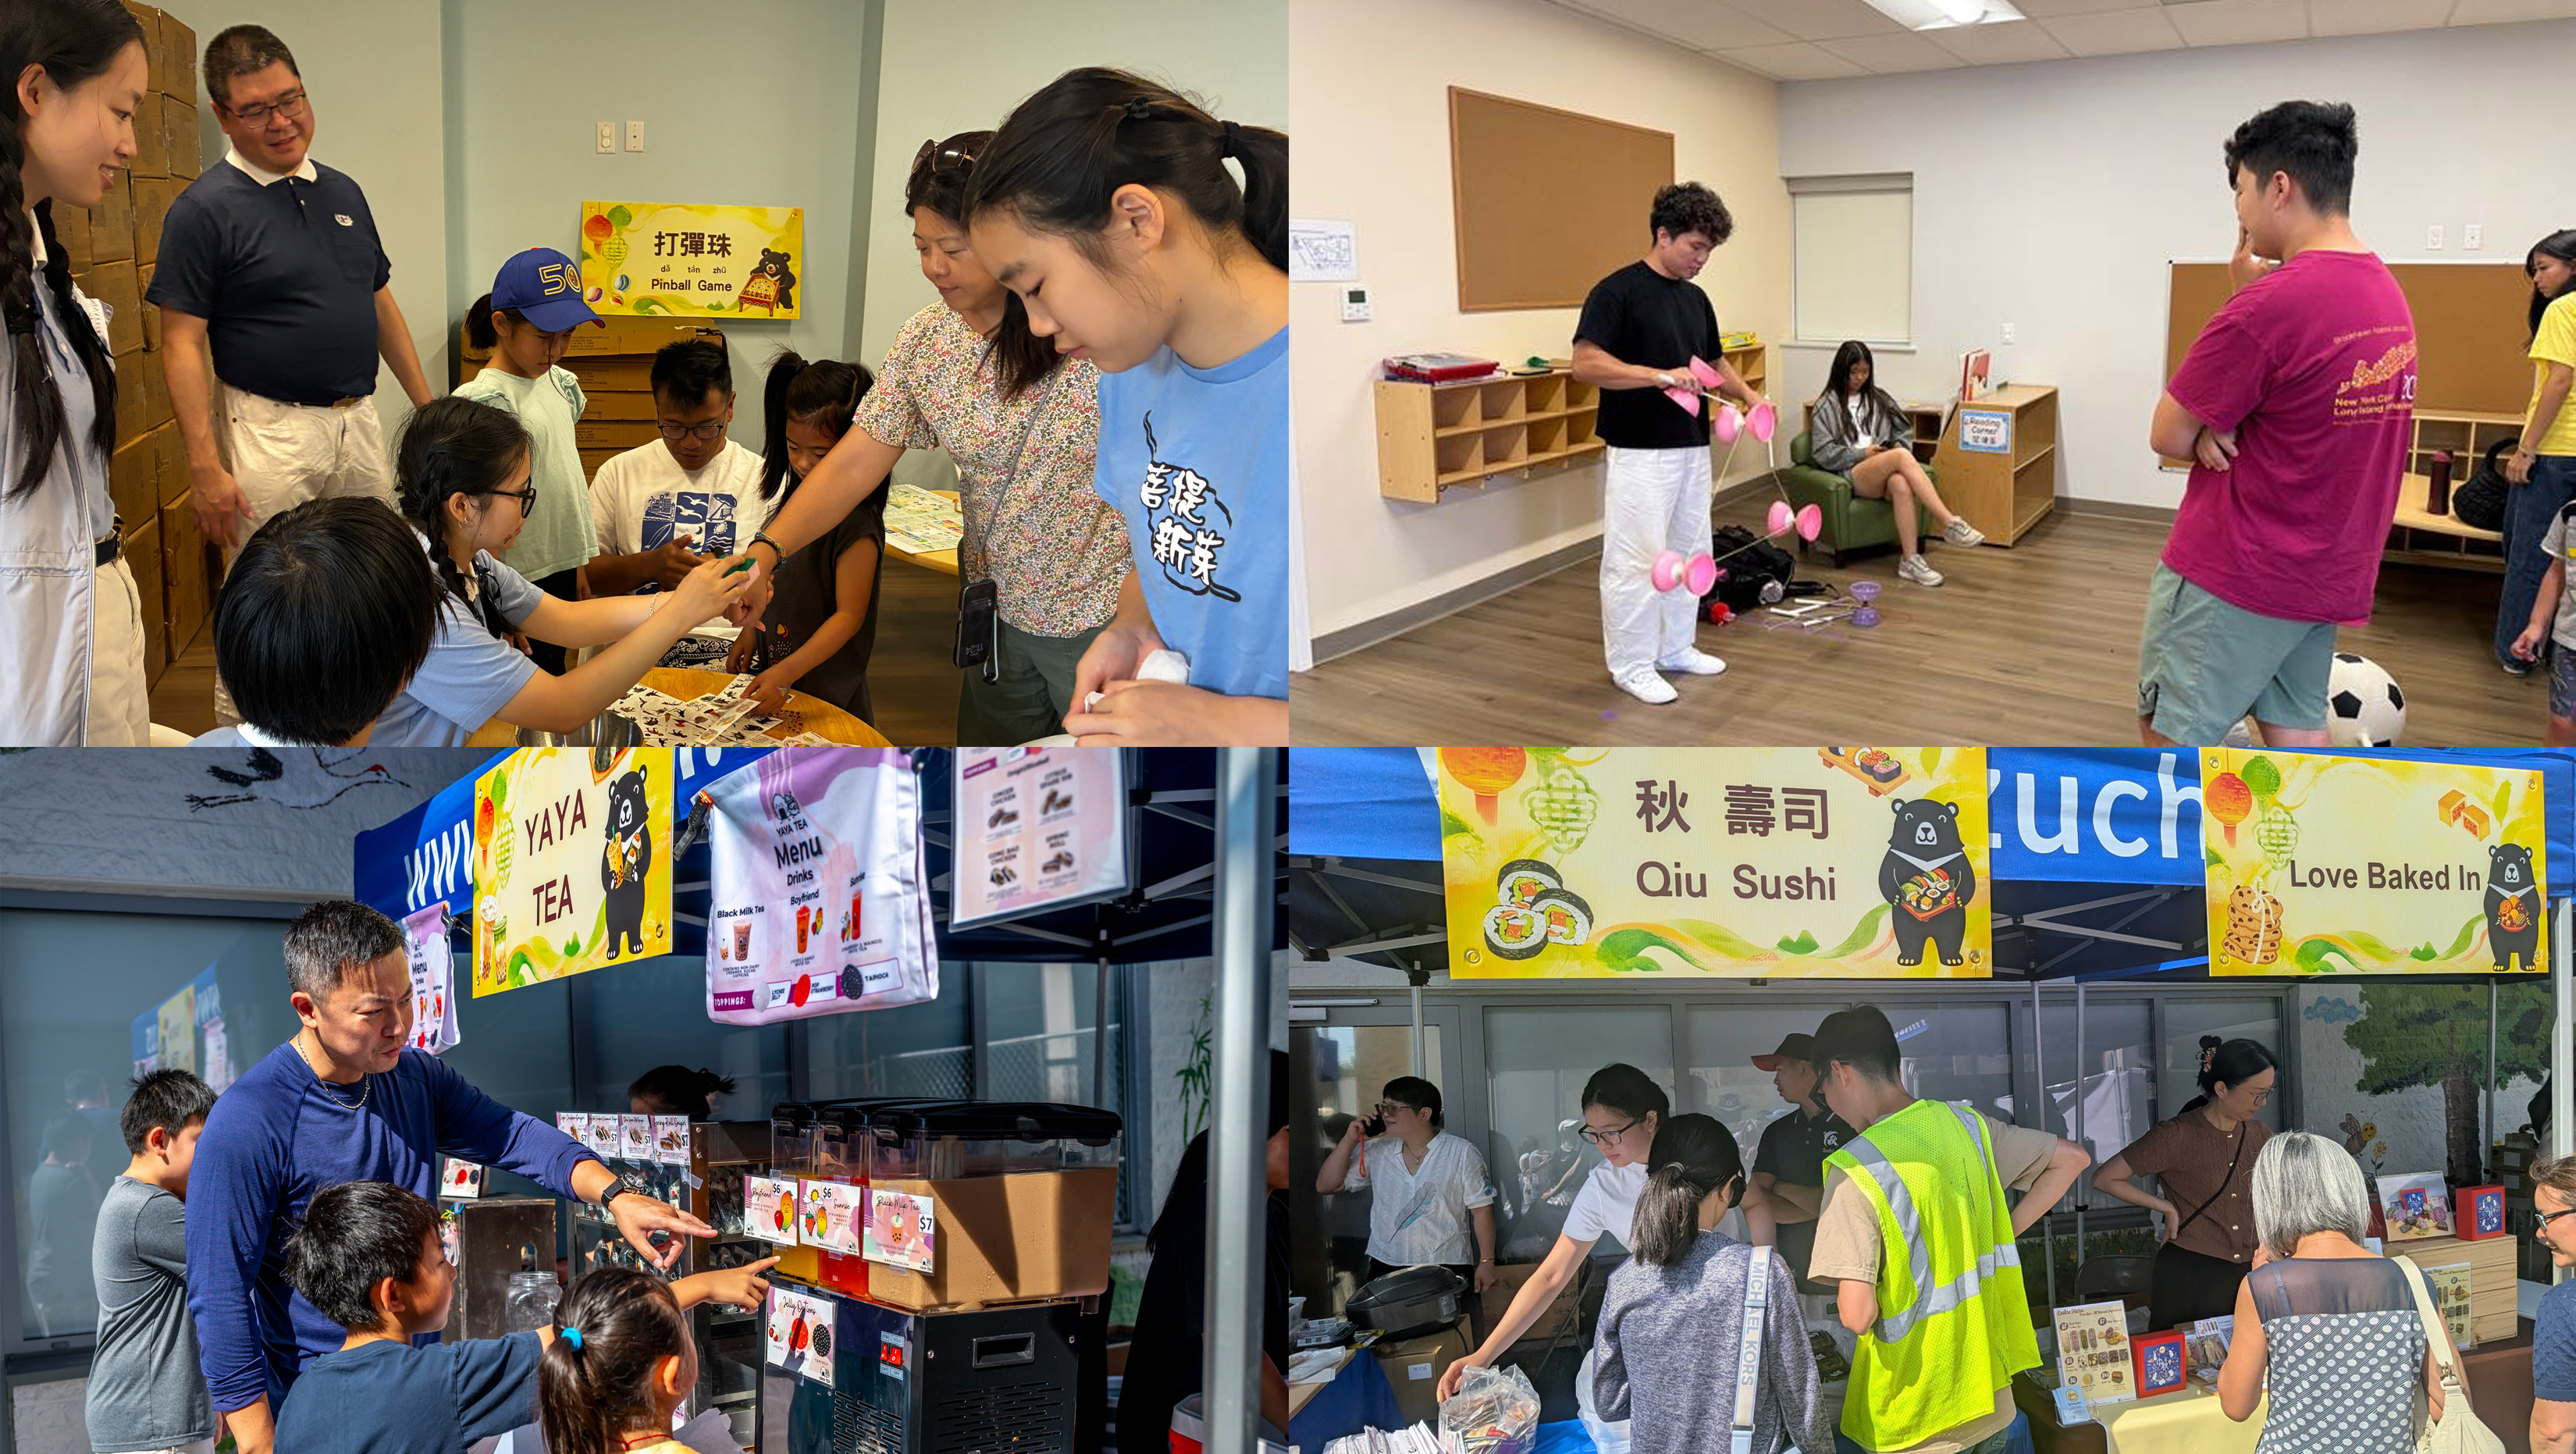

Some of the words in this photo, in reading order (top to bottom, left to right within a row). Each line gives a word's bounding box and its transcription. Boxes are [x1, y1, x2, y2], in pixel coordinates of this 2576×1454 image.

[654, 231, 731, 258] 打彈珠
[539, 264, 581, 295] 50
[651, 279, 691, 291] Pinball
[698, 280, 732, 292] Game
[1969, 418, 2001, 428] Reading
[1972, 426, 1998, 435] Corner
[1140, 462, 1208, 526] 菩提
[1636, 780, 1691, 834] 秋
[1724, 784, 1829, 840] 壽司
[1987, 753, 2206, 859] uch
[525, 789, 587, 856] YAYA
[777, 823, 794, 837] YAYA
[793, 819, 808, 830] TEA
[774, 836, 823, 869] Menu
[788, 869, 813, 886] Drinks
[1636, 861, 1707, 900] Qiu
[1734, 863, 1835, 901] Sushi
[2290, 860, 2357, 890] Love
[2368, 862, 2451, 892] Baked
[2460, 864, 2481, 892] In
[532, 874, 574, 926] TEA
[791, 889, 819, 905] Boyfriend
[717, 909, 738, 919] Black
[739, 907, 753, 916] Milk
[412, 962, 427, 976] Menu
[864, 972, 889, 982] TAPIOCA
[581, 1133, 587, 1142] $7
[611, 1133, 617, 1142] $7
[645, 1135, 650, 1144] $7
[681, 1134, 688, 1146] $7
[752, 1188, 771, 1201] Boyfriend
[773, 1182, 781, 1194] $6
[823, 1186, 832, 1199] $6
[833, 1199, 851, 1210] Sunrise
[877, 1196, 893, 1212] Black
[894, 1198, 908, 1214] Milk
[909, 1200, 920, 1211] Tea
[920, 1215, 932, 1232] $7
[783, 1296, 796, 1315] Jelly
[797, 1300, 817, 1315] Options
[1746, 1262, 1765, 1335] MICHAEL
[1741, 1340, 1758, 1386] KORS
